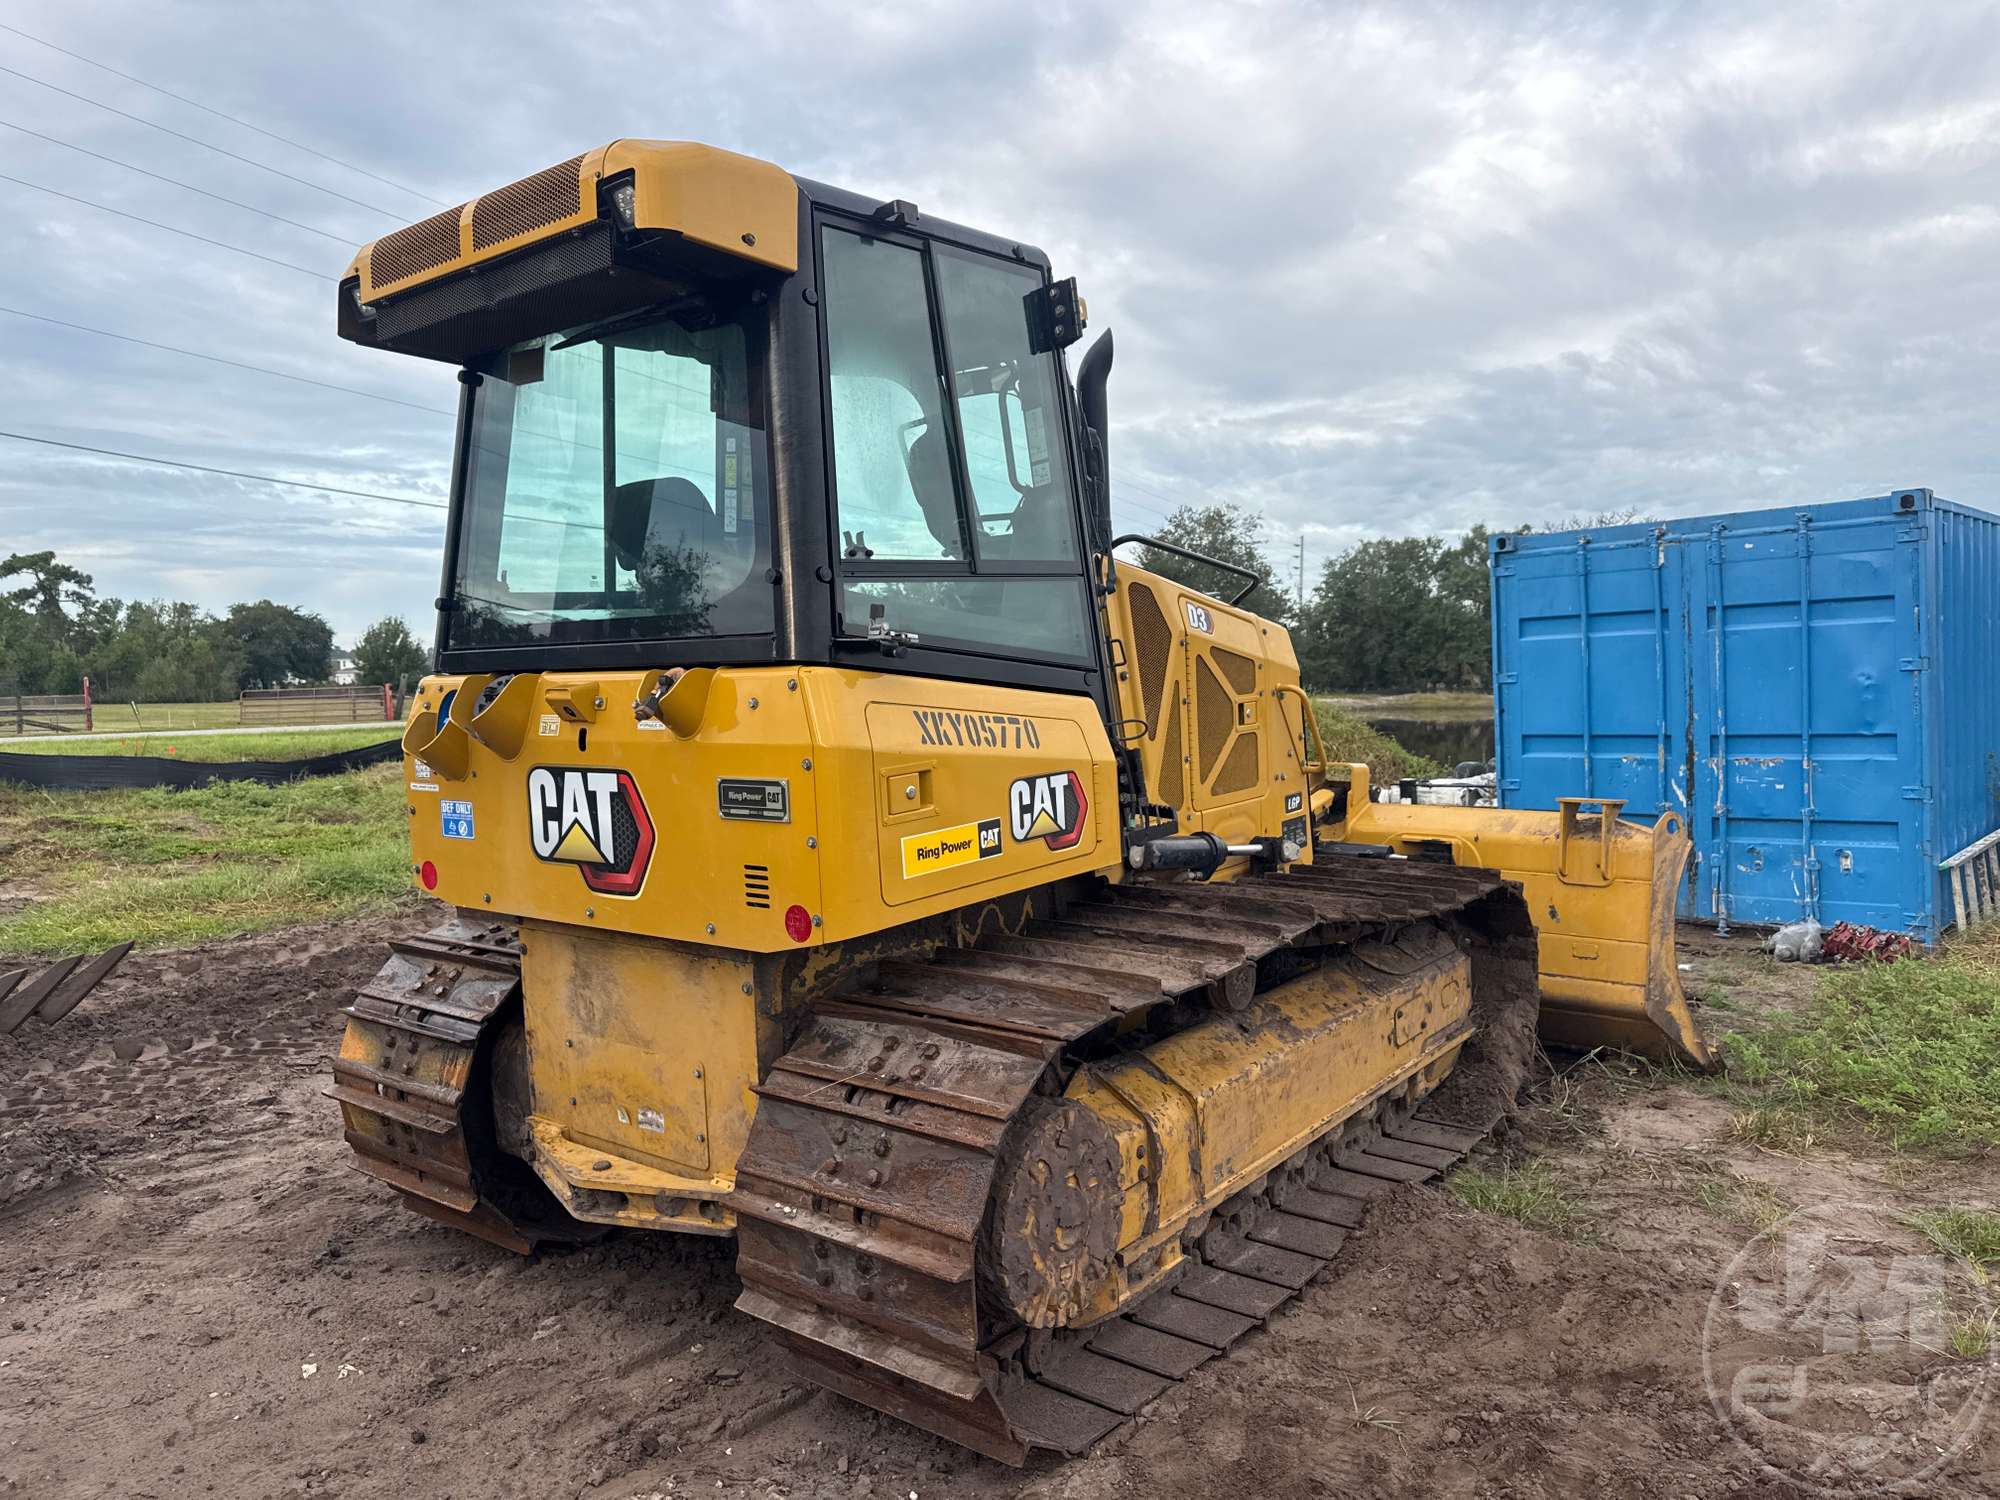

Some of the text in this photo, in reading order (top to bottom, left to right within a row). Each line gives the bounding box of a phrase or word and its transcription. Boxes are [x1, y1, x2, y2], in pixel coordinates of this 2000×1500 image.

[1187, 603, 1208, 632] D3
[912, 709, 1041, 750] XKY05770
[442, 802, 471, 814] DEF ONLY
[767, 791, 780, 803] CAT
[1010, 773, 1069, 842] CAT
[1288, 796, 1301, 811] LGP
[529, 768, 619, 865] CAT
[980, 827, 1000, 849] CAT
[917, 839, 973, 861] Ring Power
